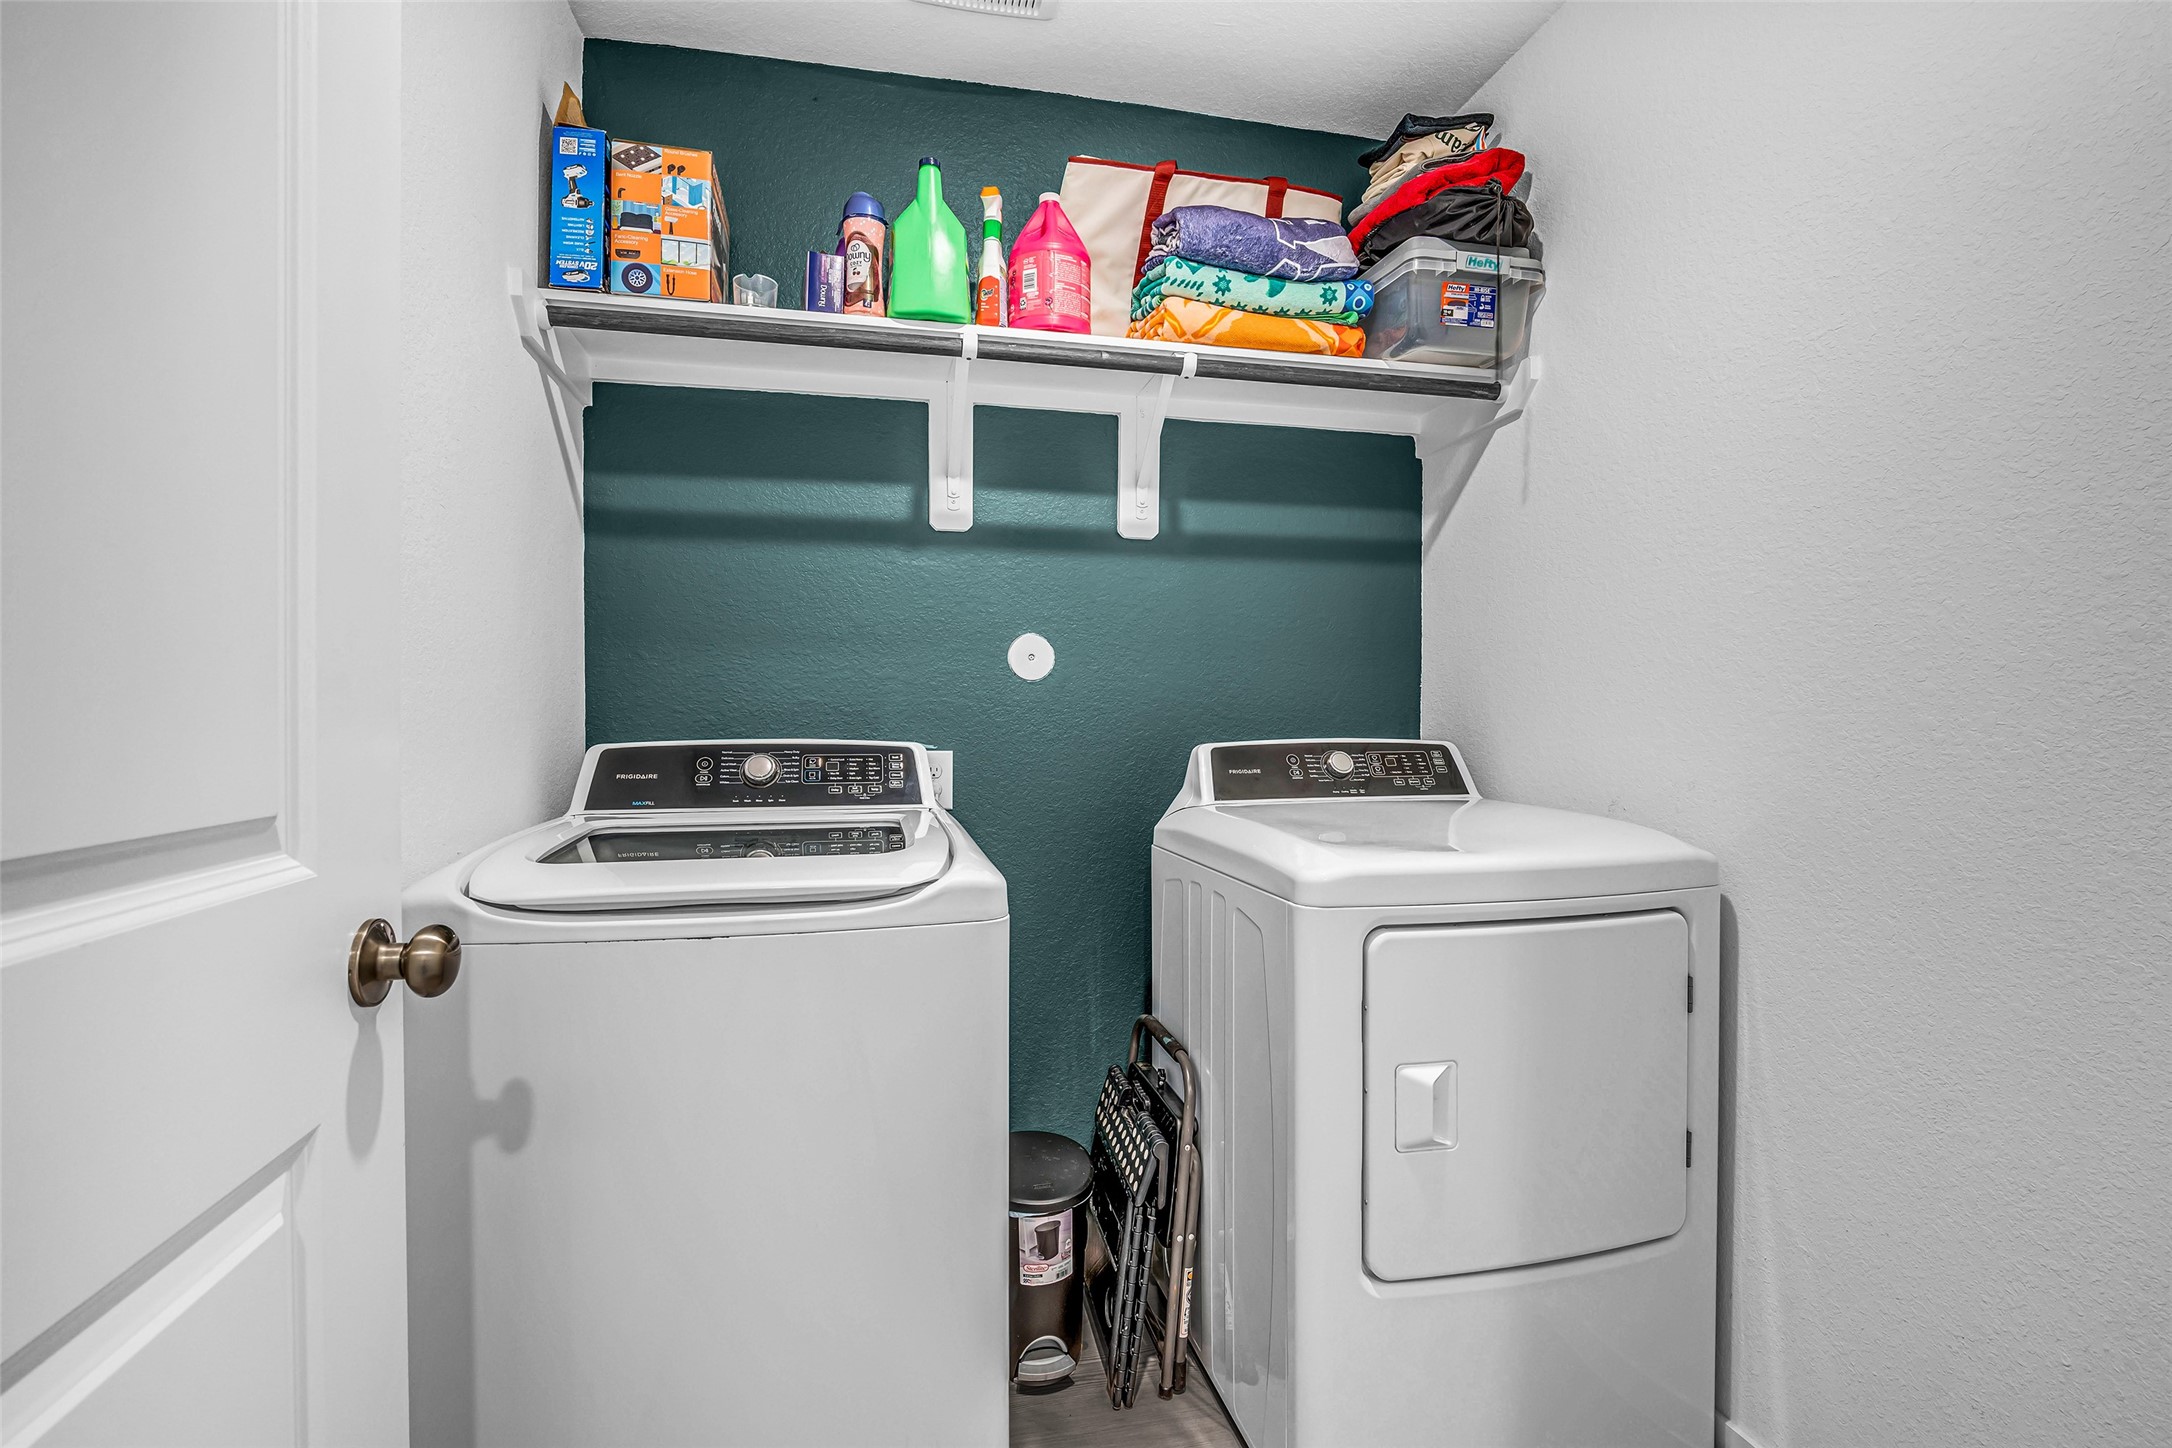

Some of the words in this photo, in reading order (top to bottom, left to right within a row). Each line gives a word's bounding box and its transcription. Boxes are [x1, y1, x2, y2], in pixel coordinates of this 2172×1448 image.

[1468, 256, 1503, 272] Hefty
[817, 284, 828, 307] Downy
[1447, 284, 1466, 292] Hefty
